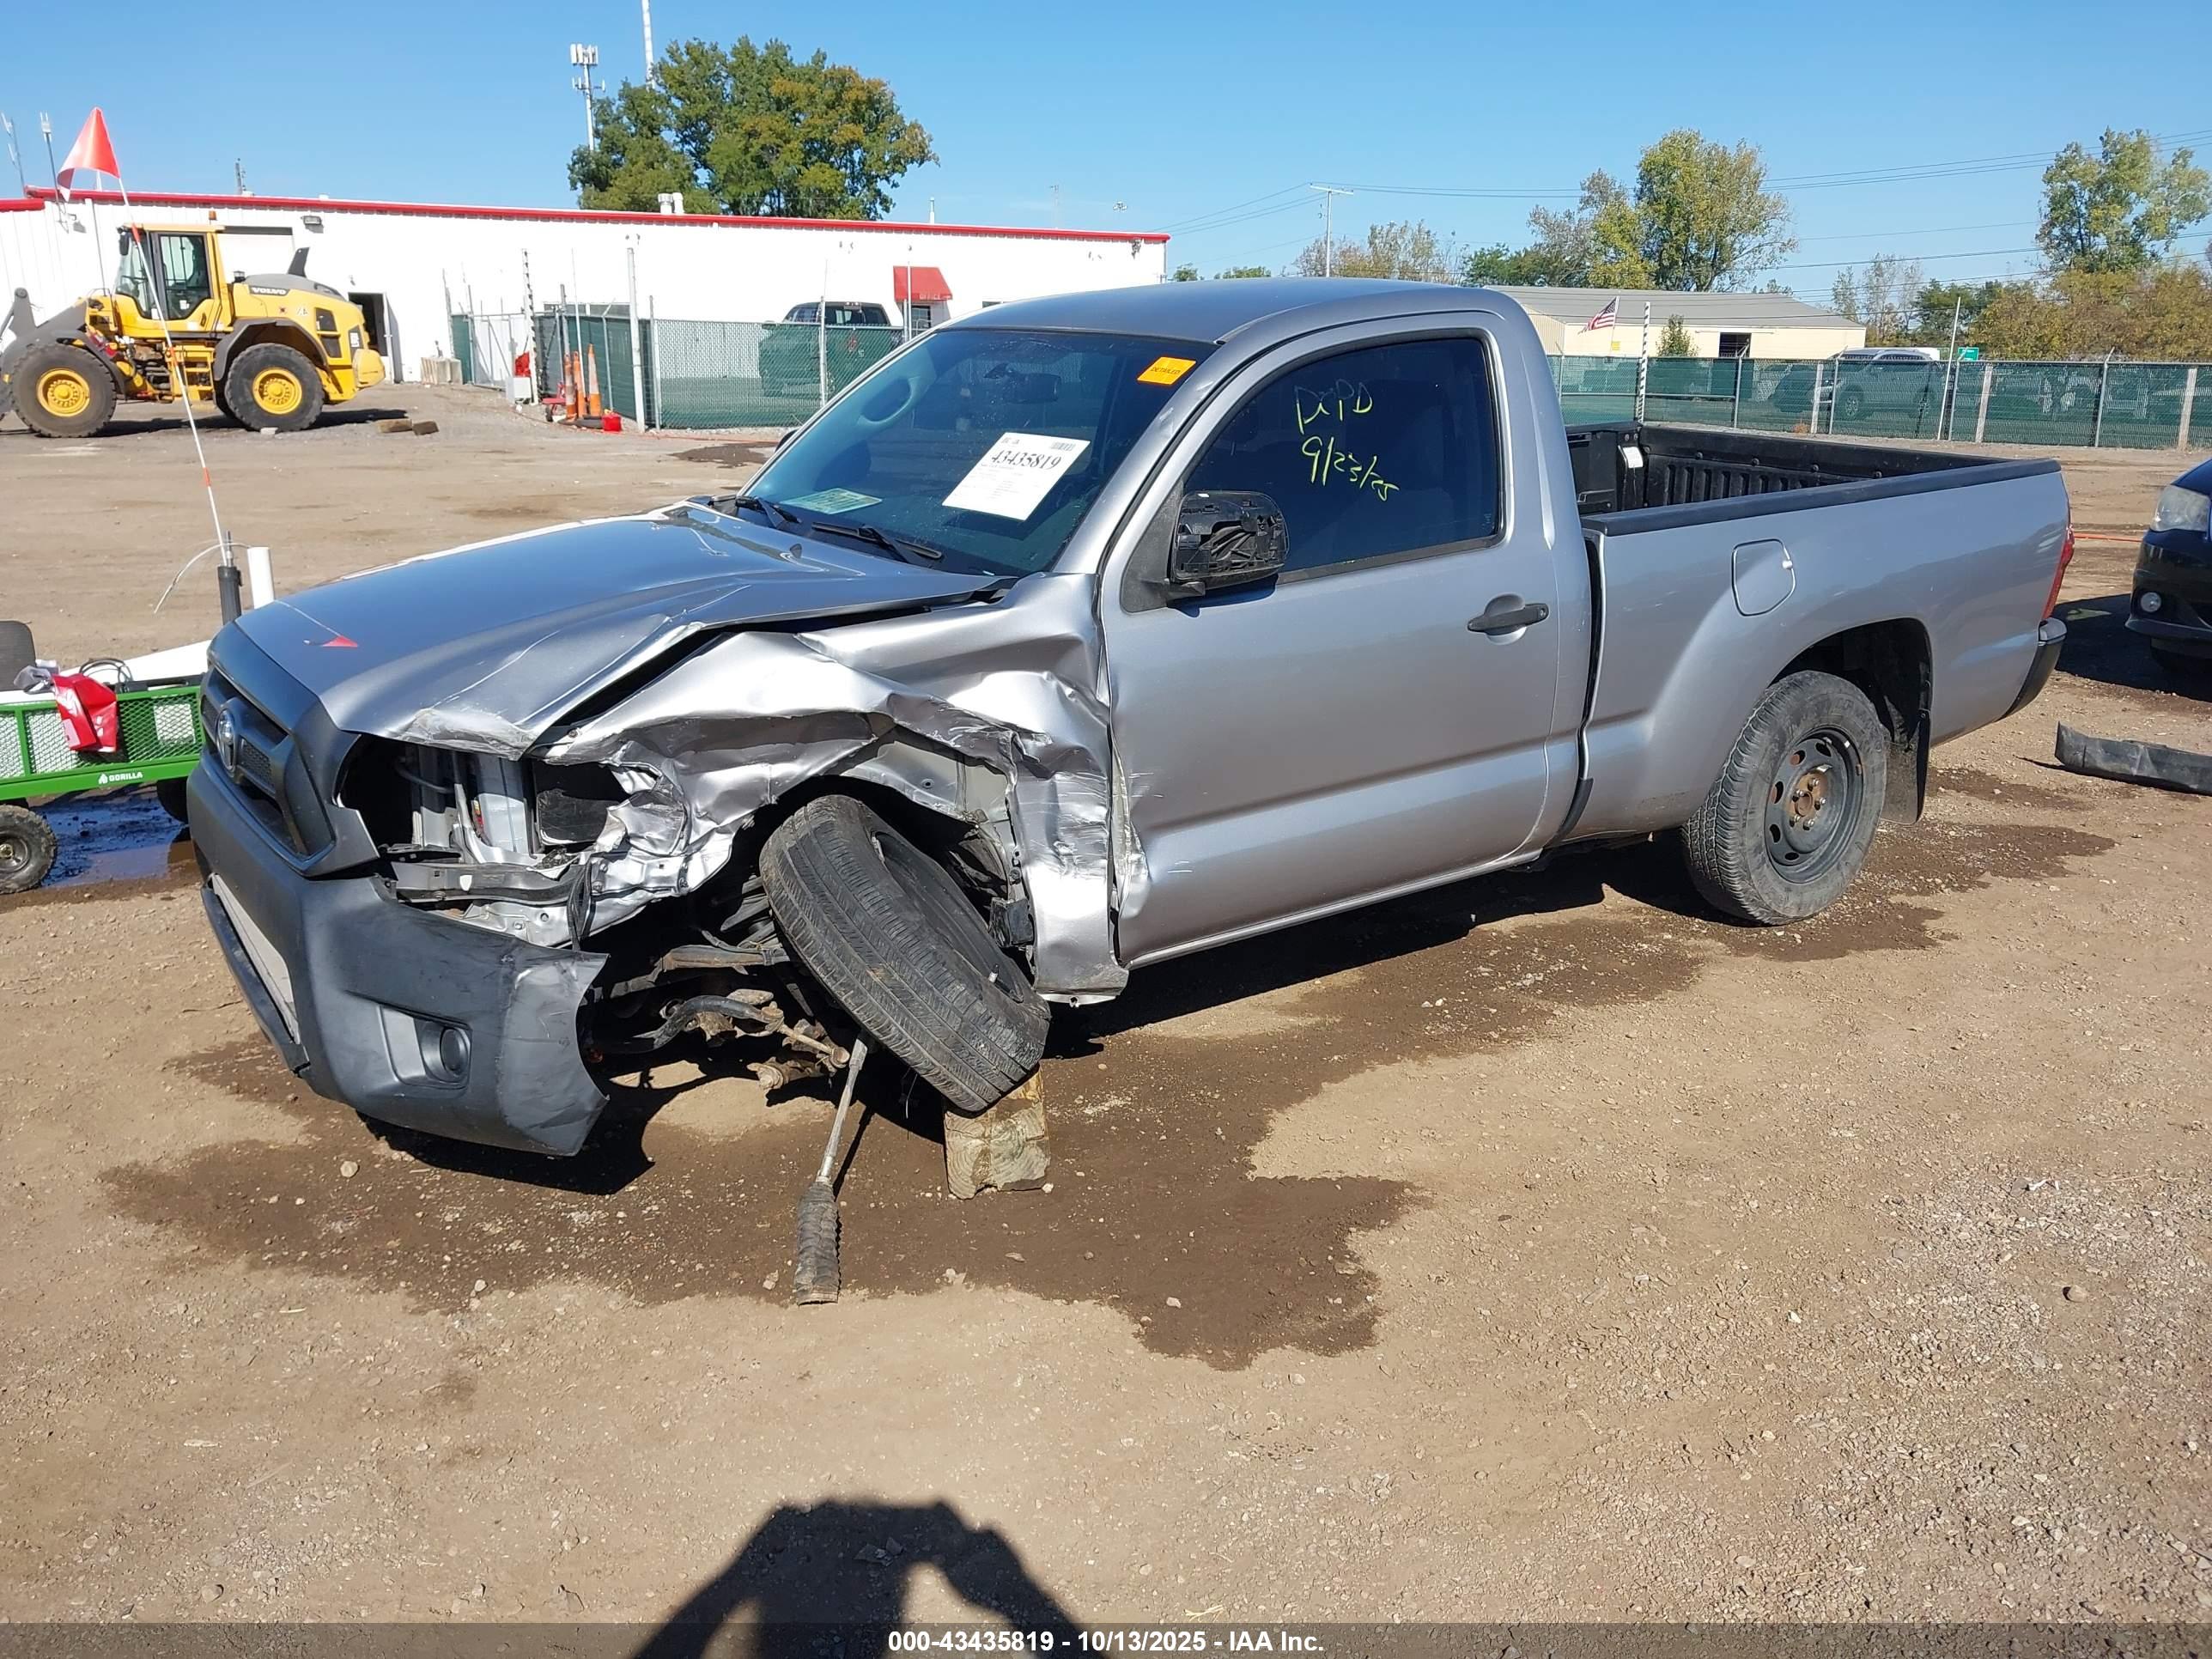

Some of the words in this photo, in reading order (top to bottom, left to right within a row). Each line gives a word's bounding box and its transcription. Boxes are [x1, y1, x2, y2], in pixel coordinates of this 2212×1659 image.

[251, 287, 287, 295] VOLVO
[991, 449, 1063, 470] 43435819
[109, 772, 143, 781] GORILLA
